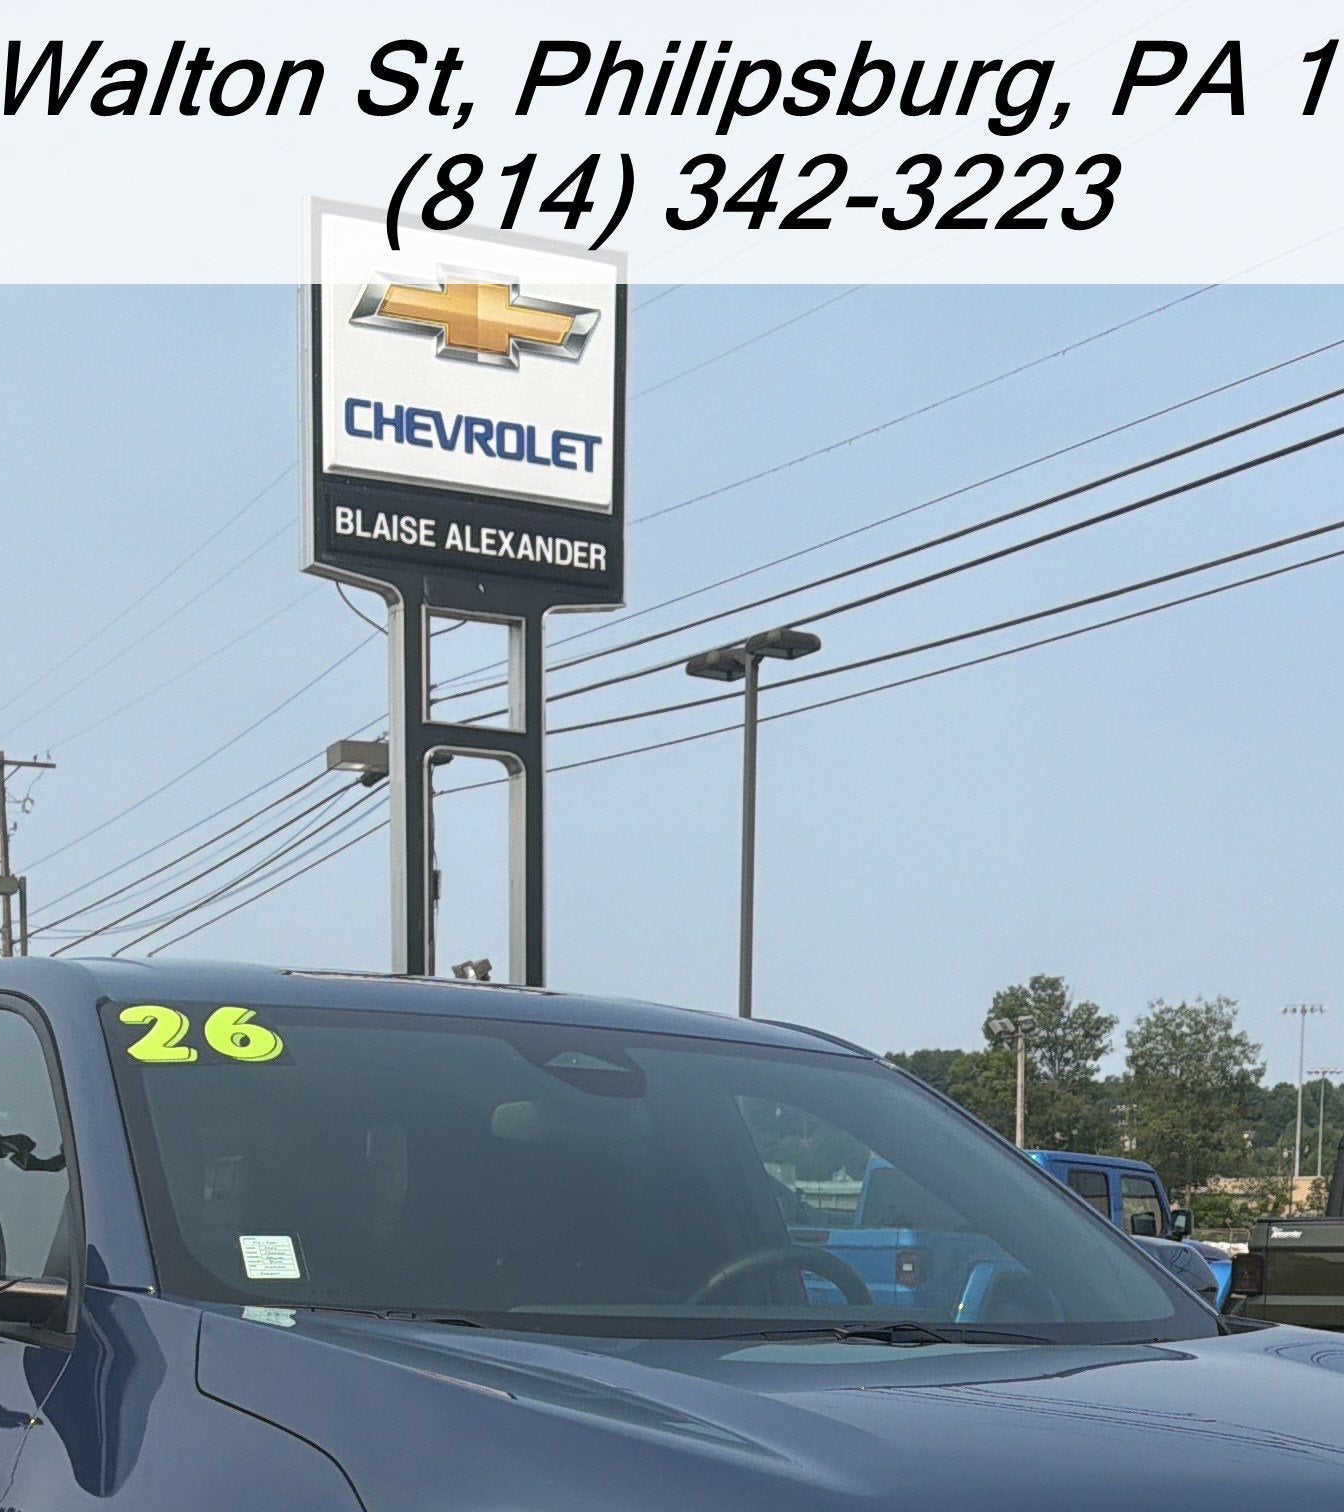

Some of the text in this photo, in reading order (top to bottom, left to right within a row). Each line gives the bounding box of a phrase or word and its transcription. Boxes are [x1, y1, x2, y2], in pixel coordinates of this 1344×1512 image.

[343, 396, 603, 474] CHEVROLET
[335, 505, 607, 571] BLAISE ALEXANDER
[119, 1005, 285, 1064] 26
